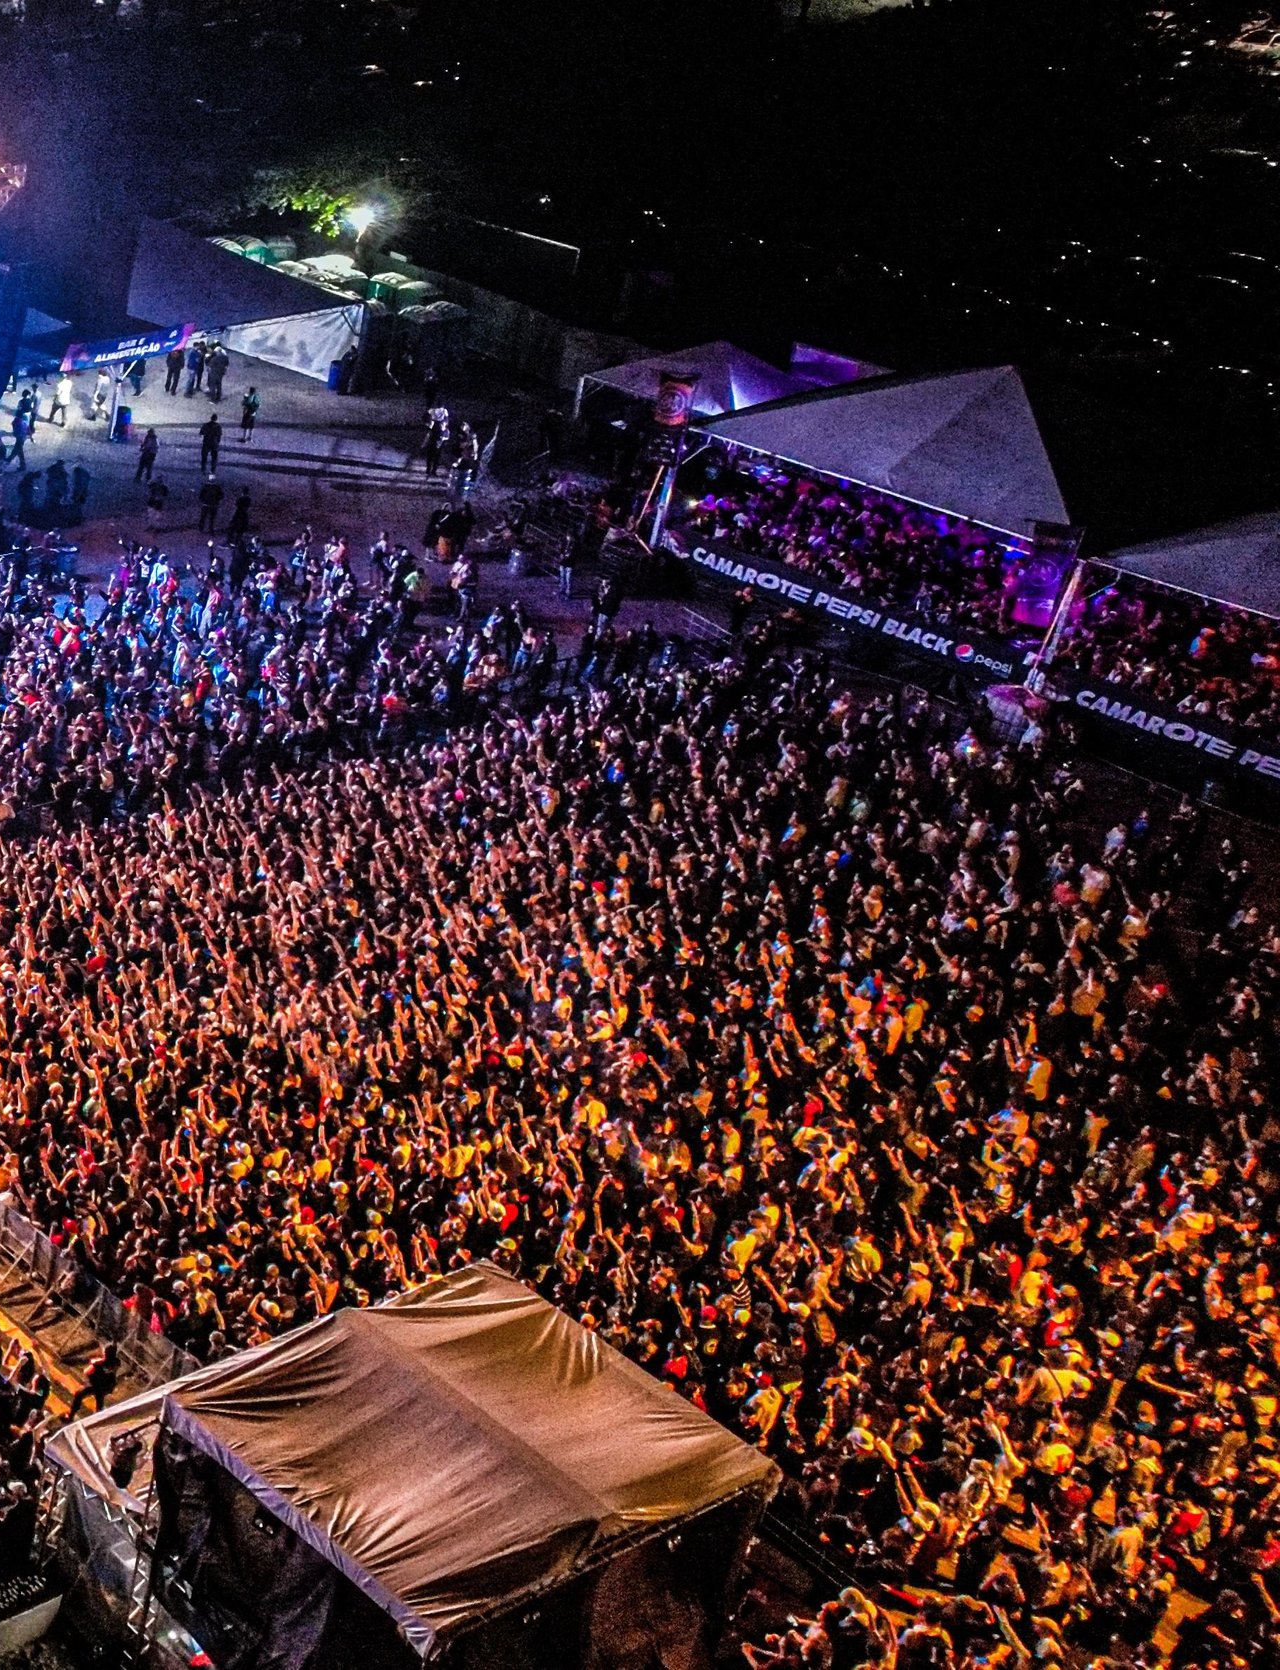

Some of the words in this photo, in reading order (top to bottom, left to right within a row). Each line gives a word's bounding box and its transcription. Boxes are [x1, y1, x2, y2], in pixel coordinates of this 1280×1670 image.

[692, 546, 814, 604] CAMAROTE
[813, 591, 882, 629] PEPSI
[881, 619, 954, 656] BLACK
[973, 653, 1013, 674] pepsi
[1075, 690, 1238, 760] CAMAROTE
